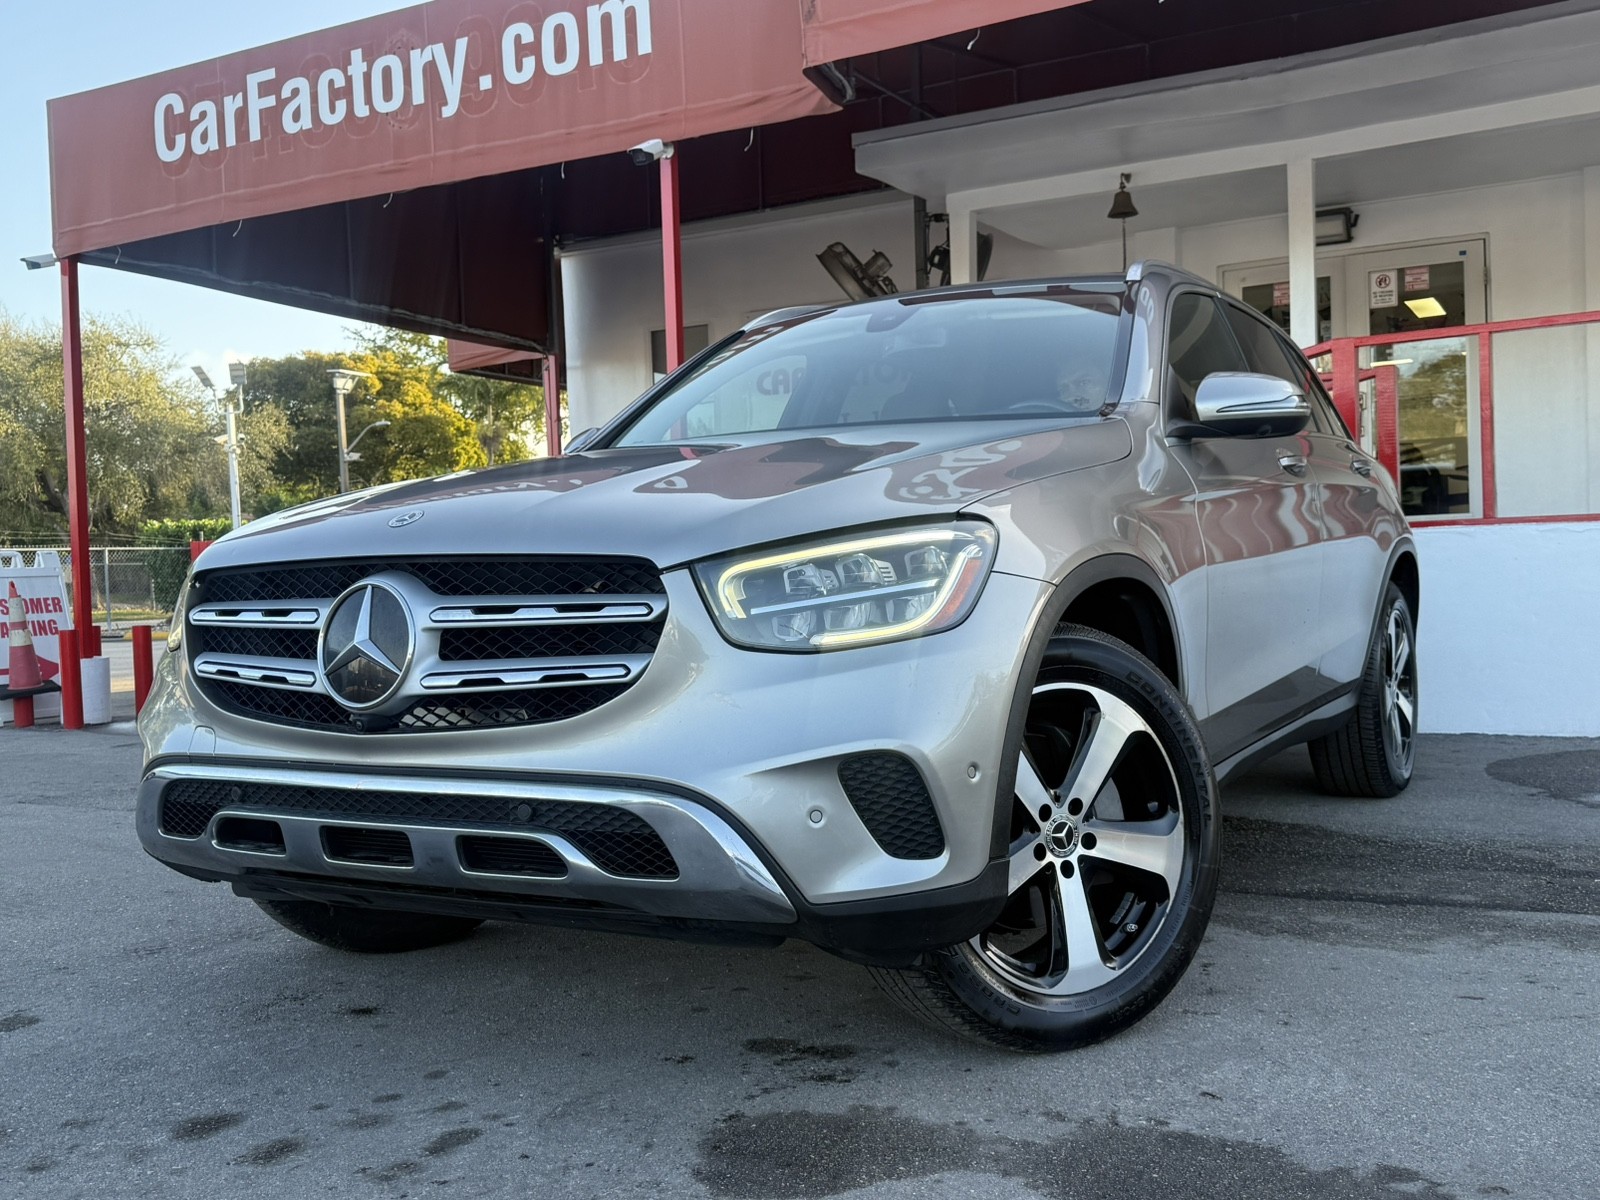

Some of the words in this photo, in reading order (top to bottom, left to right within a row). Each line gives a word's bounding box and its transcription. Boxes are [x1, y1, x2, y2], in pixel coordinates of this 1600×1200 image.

[153, 0, 653, 163] CarFactory.com
[0, 619, 59, 638] AING
[1125, 671, 1212, 830] CONTINENTAL
